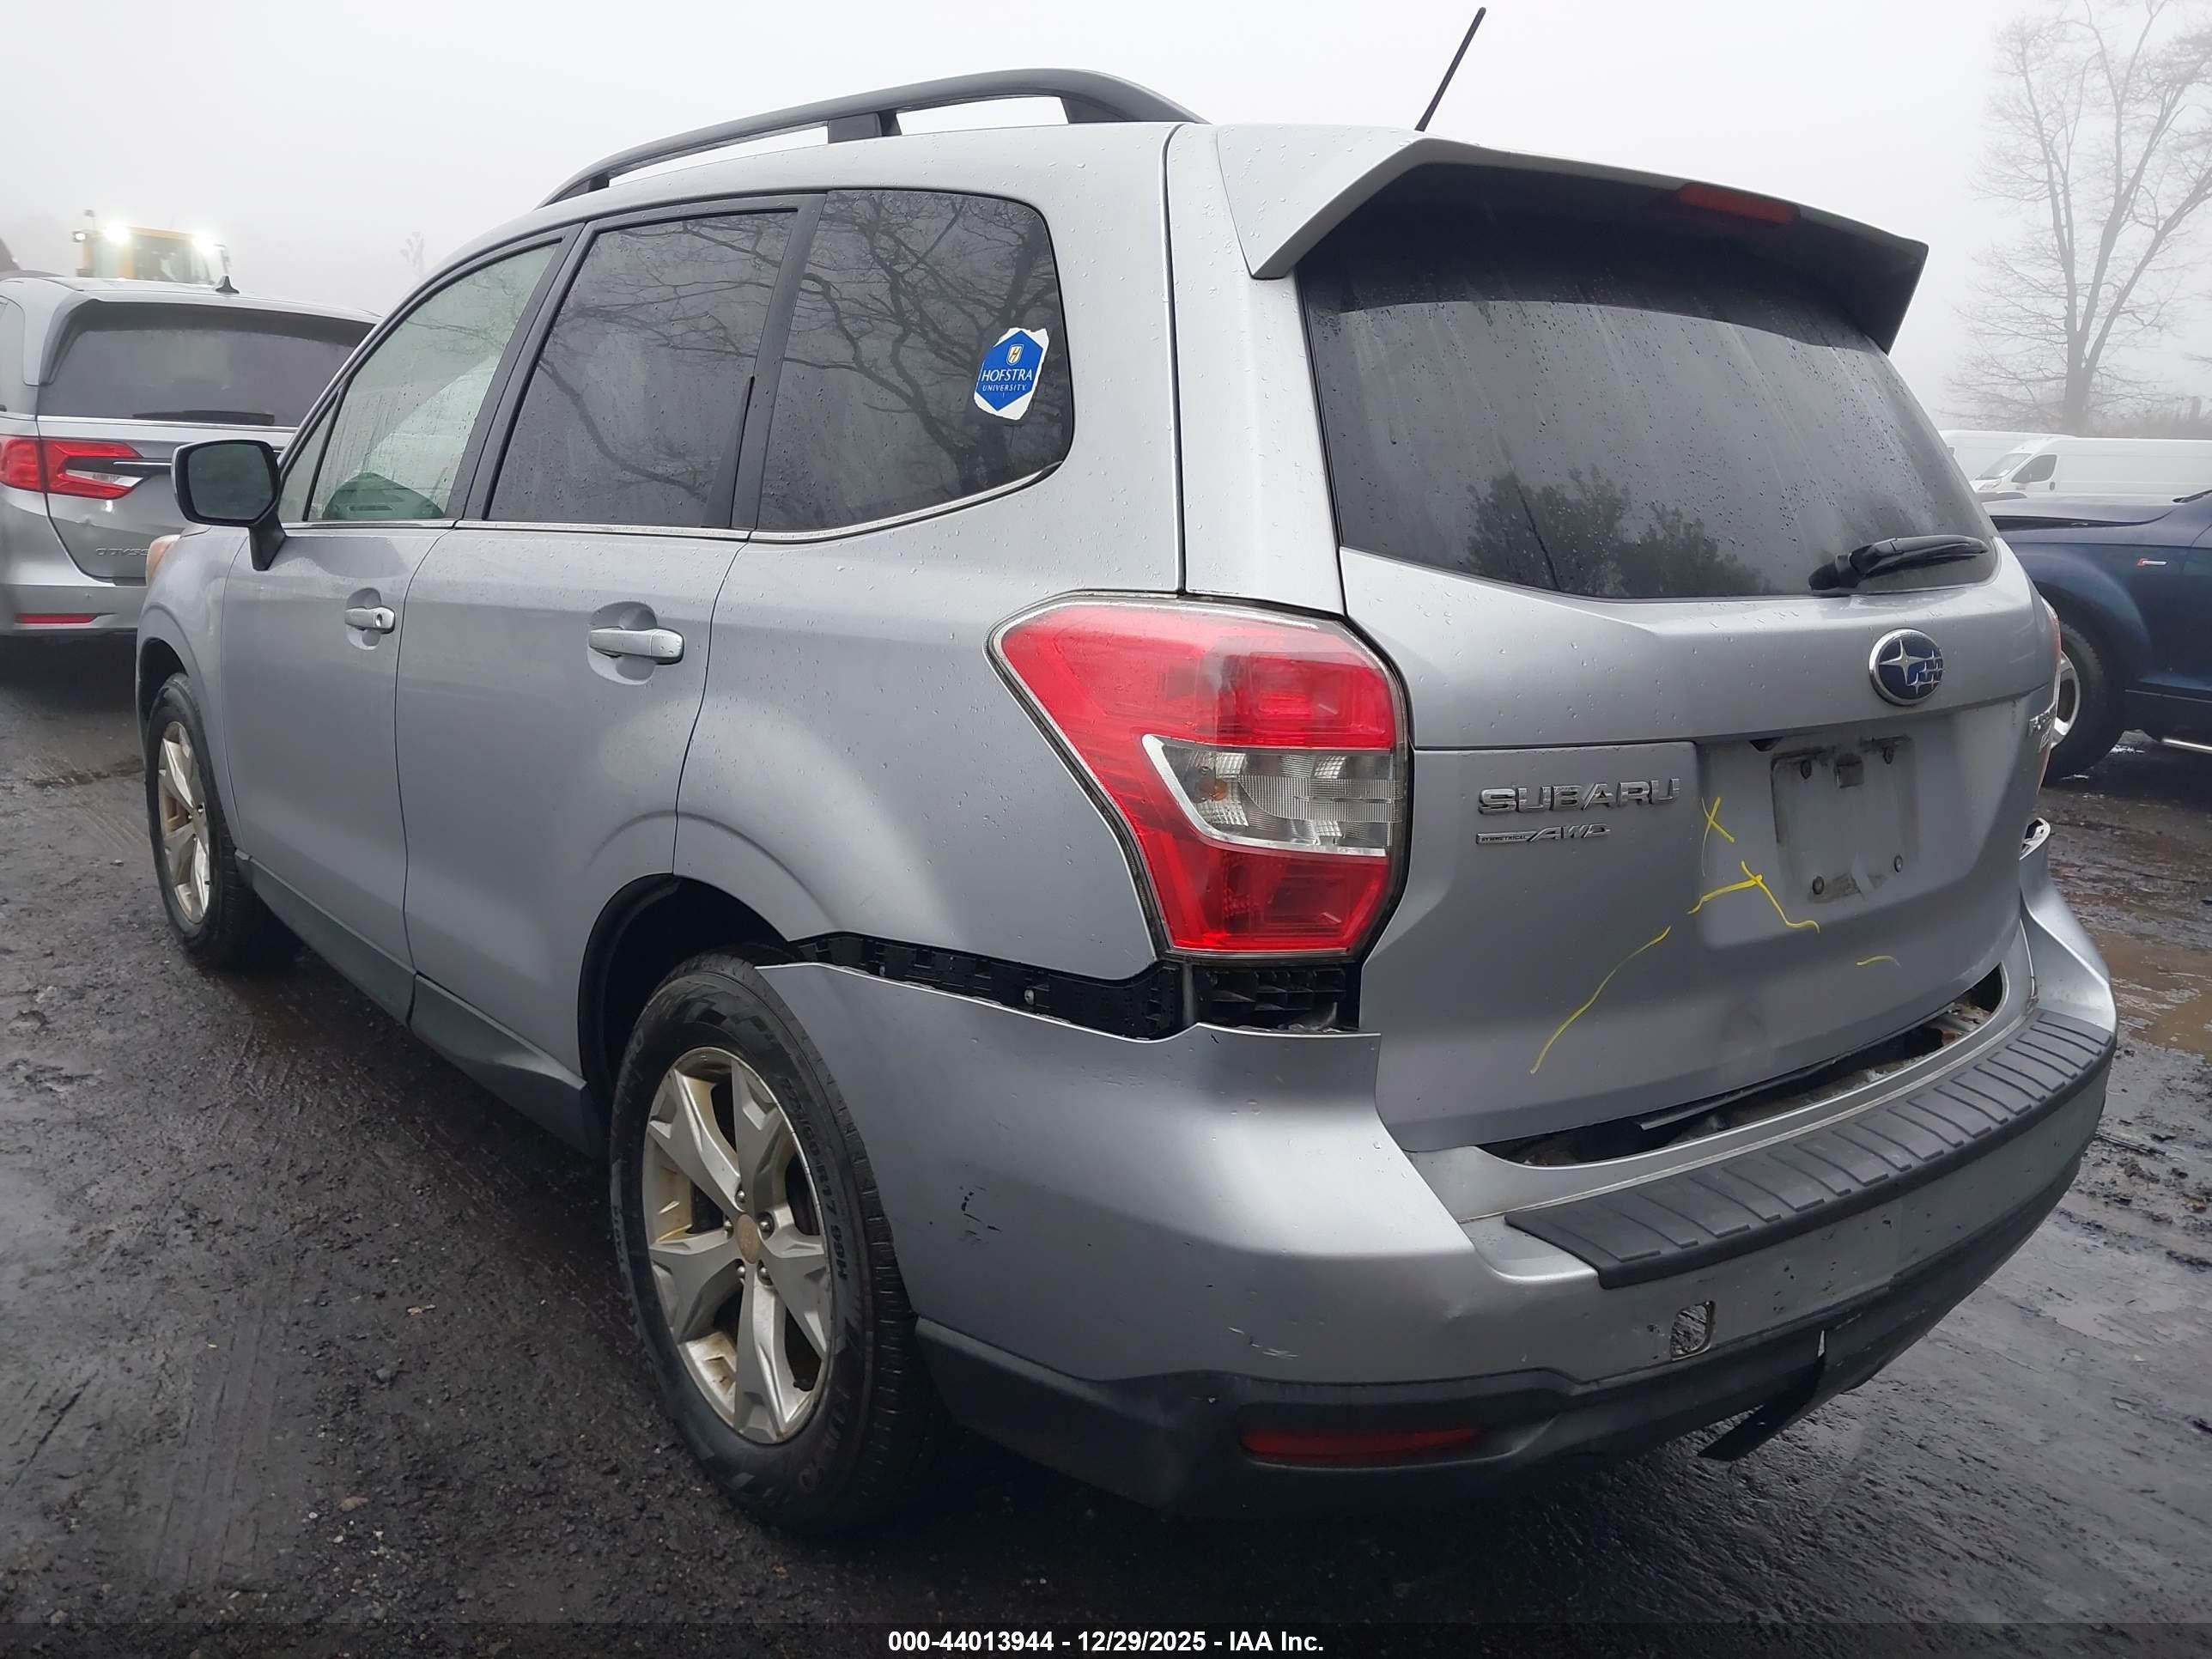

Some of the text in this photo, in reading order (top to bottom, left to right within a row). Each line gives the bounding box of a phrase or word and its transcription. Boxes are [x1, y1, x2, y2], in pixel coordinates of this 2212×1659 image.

[981, 368, 1033, 382] HOFSTRA
[1478, 777, 1681, 815] SUBARU
[1528, 823, 1611, 842] AWD
